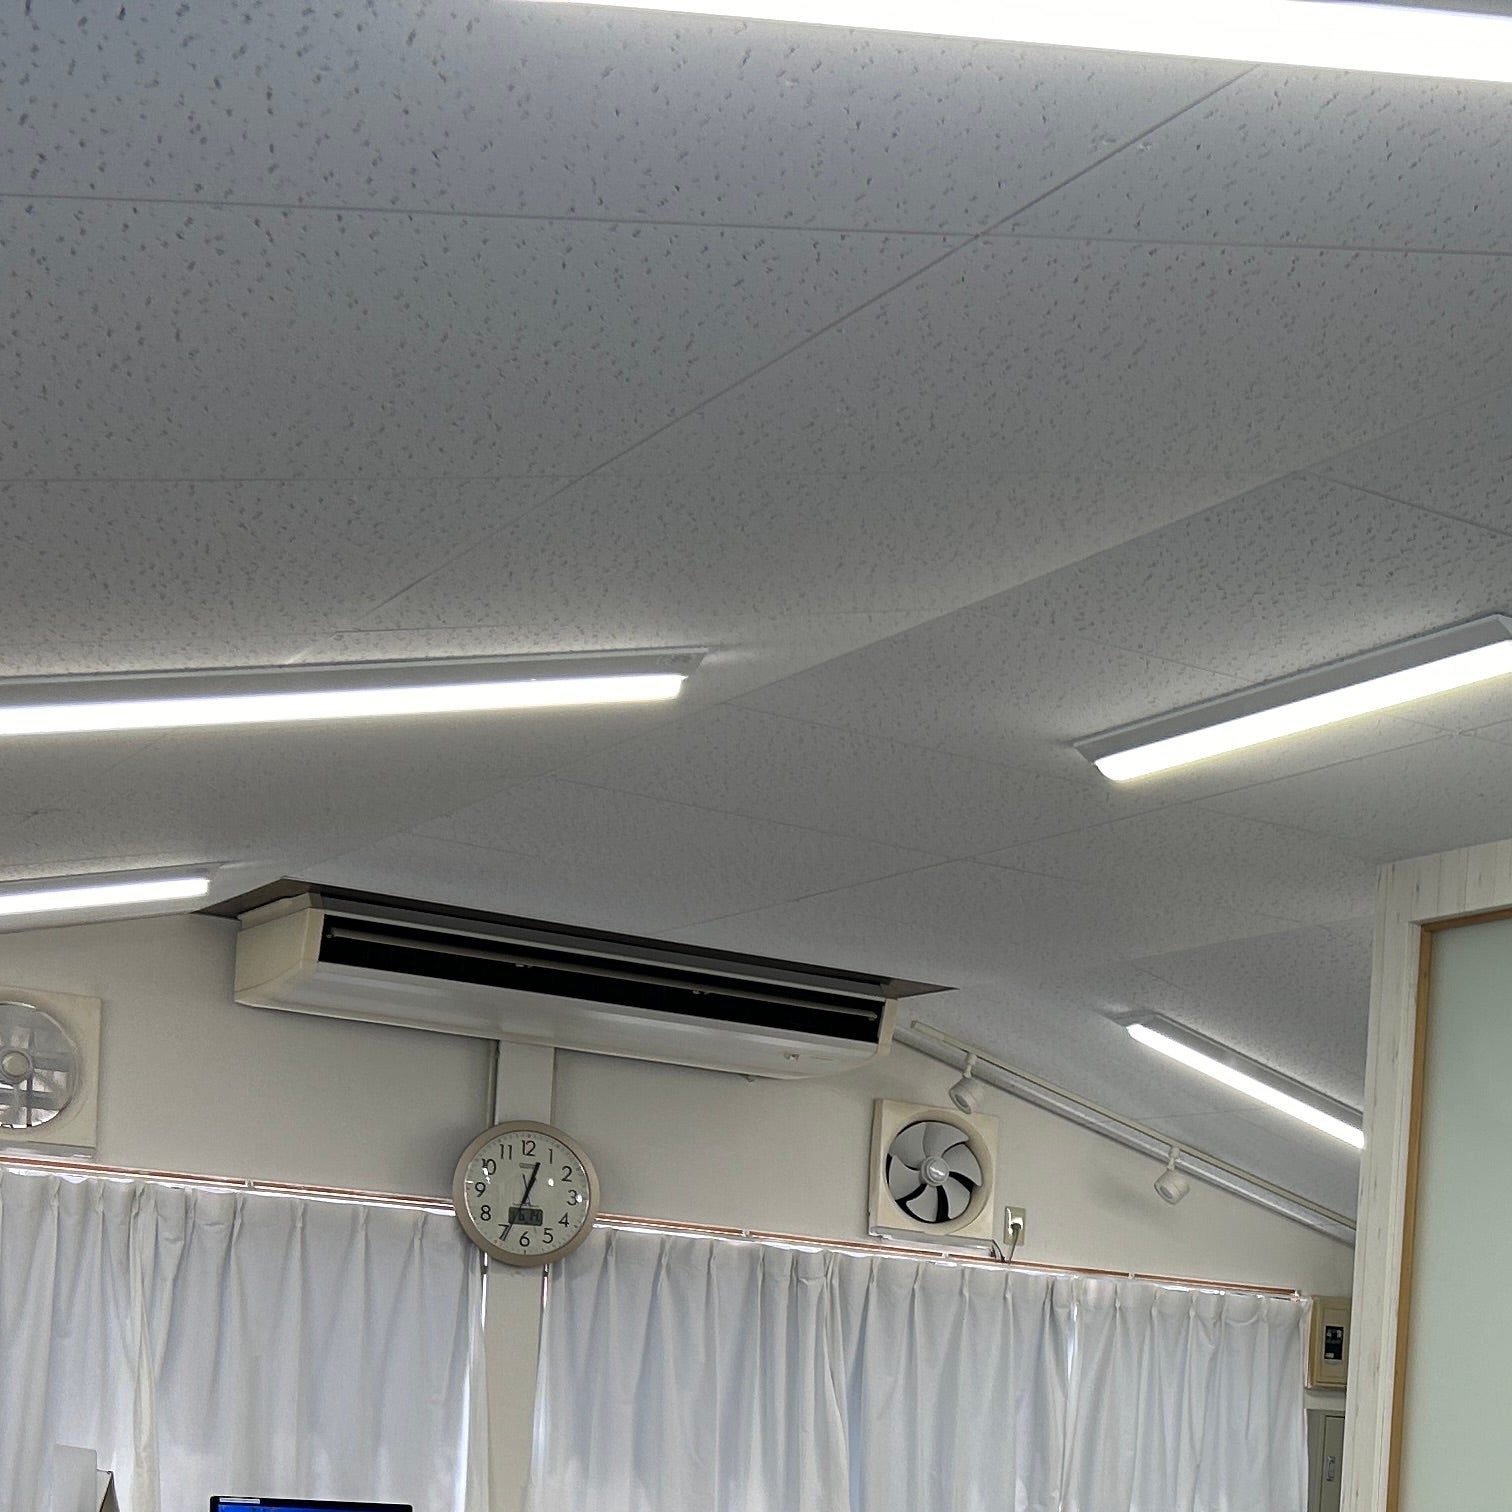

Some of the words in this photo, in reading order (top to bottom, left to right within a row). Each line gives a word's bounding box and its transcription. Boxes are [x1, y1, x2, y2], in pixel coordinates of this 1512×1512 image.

[500, 1144, 513, 1160] 11
[522, 1140, 536, 1157] 12
[548, 1149, 553, 1164] 1
[482, 1158, 497, 1176] 10
[561, 1165, 573, 1182] 2
[475, 1181, 486, 1197] 9
[567, 1190, 578, 1206] 3
[480, 1205, 491, 1221] 8
[558, 1213, 570, 1228] 4
[498, 1224, 509, 1240] 7
[519, 1231, 530, 1247] 6
[542, 1228, 554, 1244] 5
